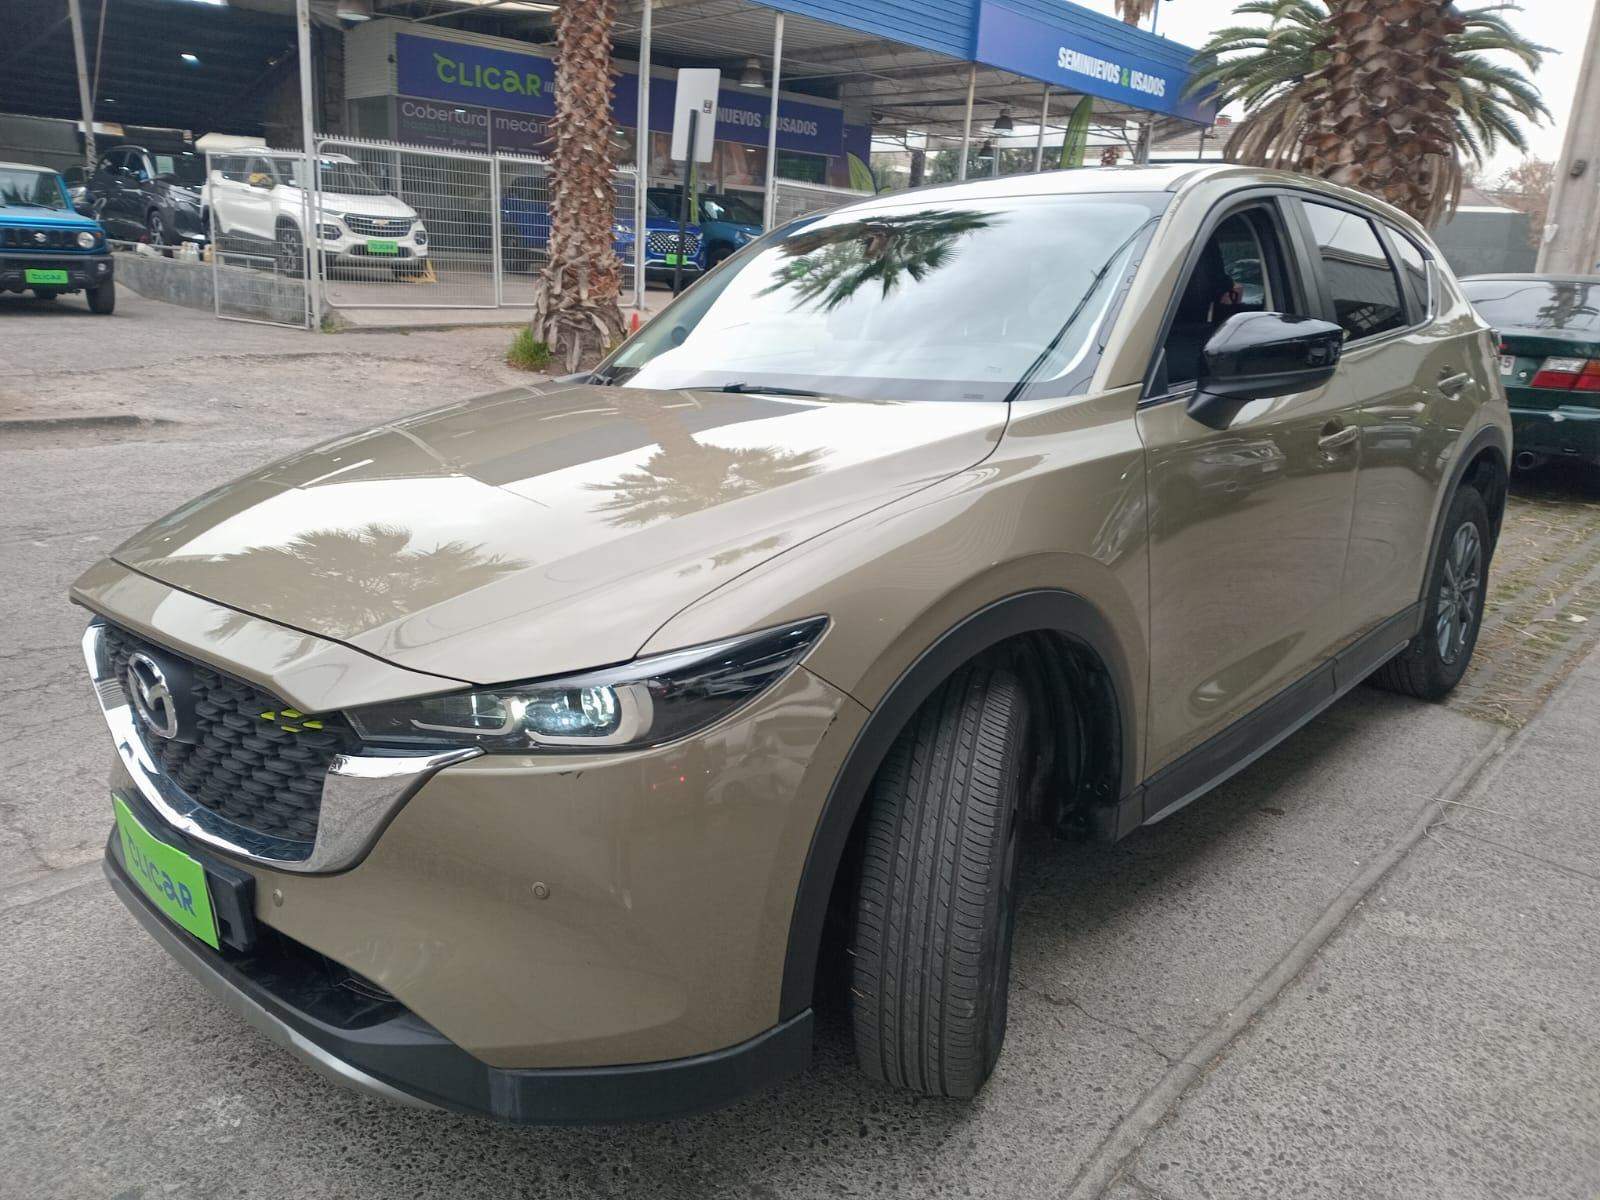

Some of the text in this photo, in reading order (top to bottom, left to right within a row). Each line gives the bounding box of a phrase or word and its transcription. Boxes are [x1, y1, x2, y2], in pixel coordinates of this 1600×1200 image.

[1058, 47, 1165, 97] SEMINUEVOS & USADOS
[402, 103, 488, 127] Cobertura
[495, 118, 549, 135] mecán
[717, 107, 762, 128] NUEVOS
